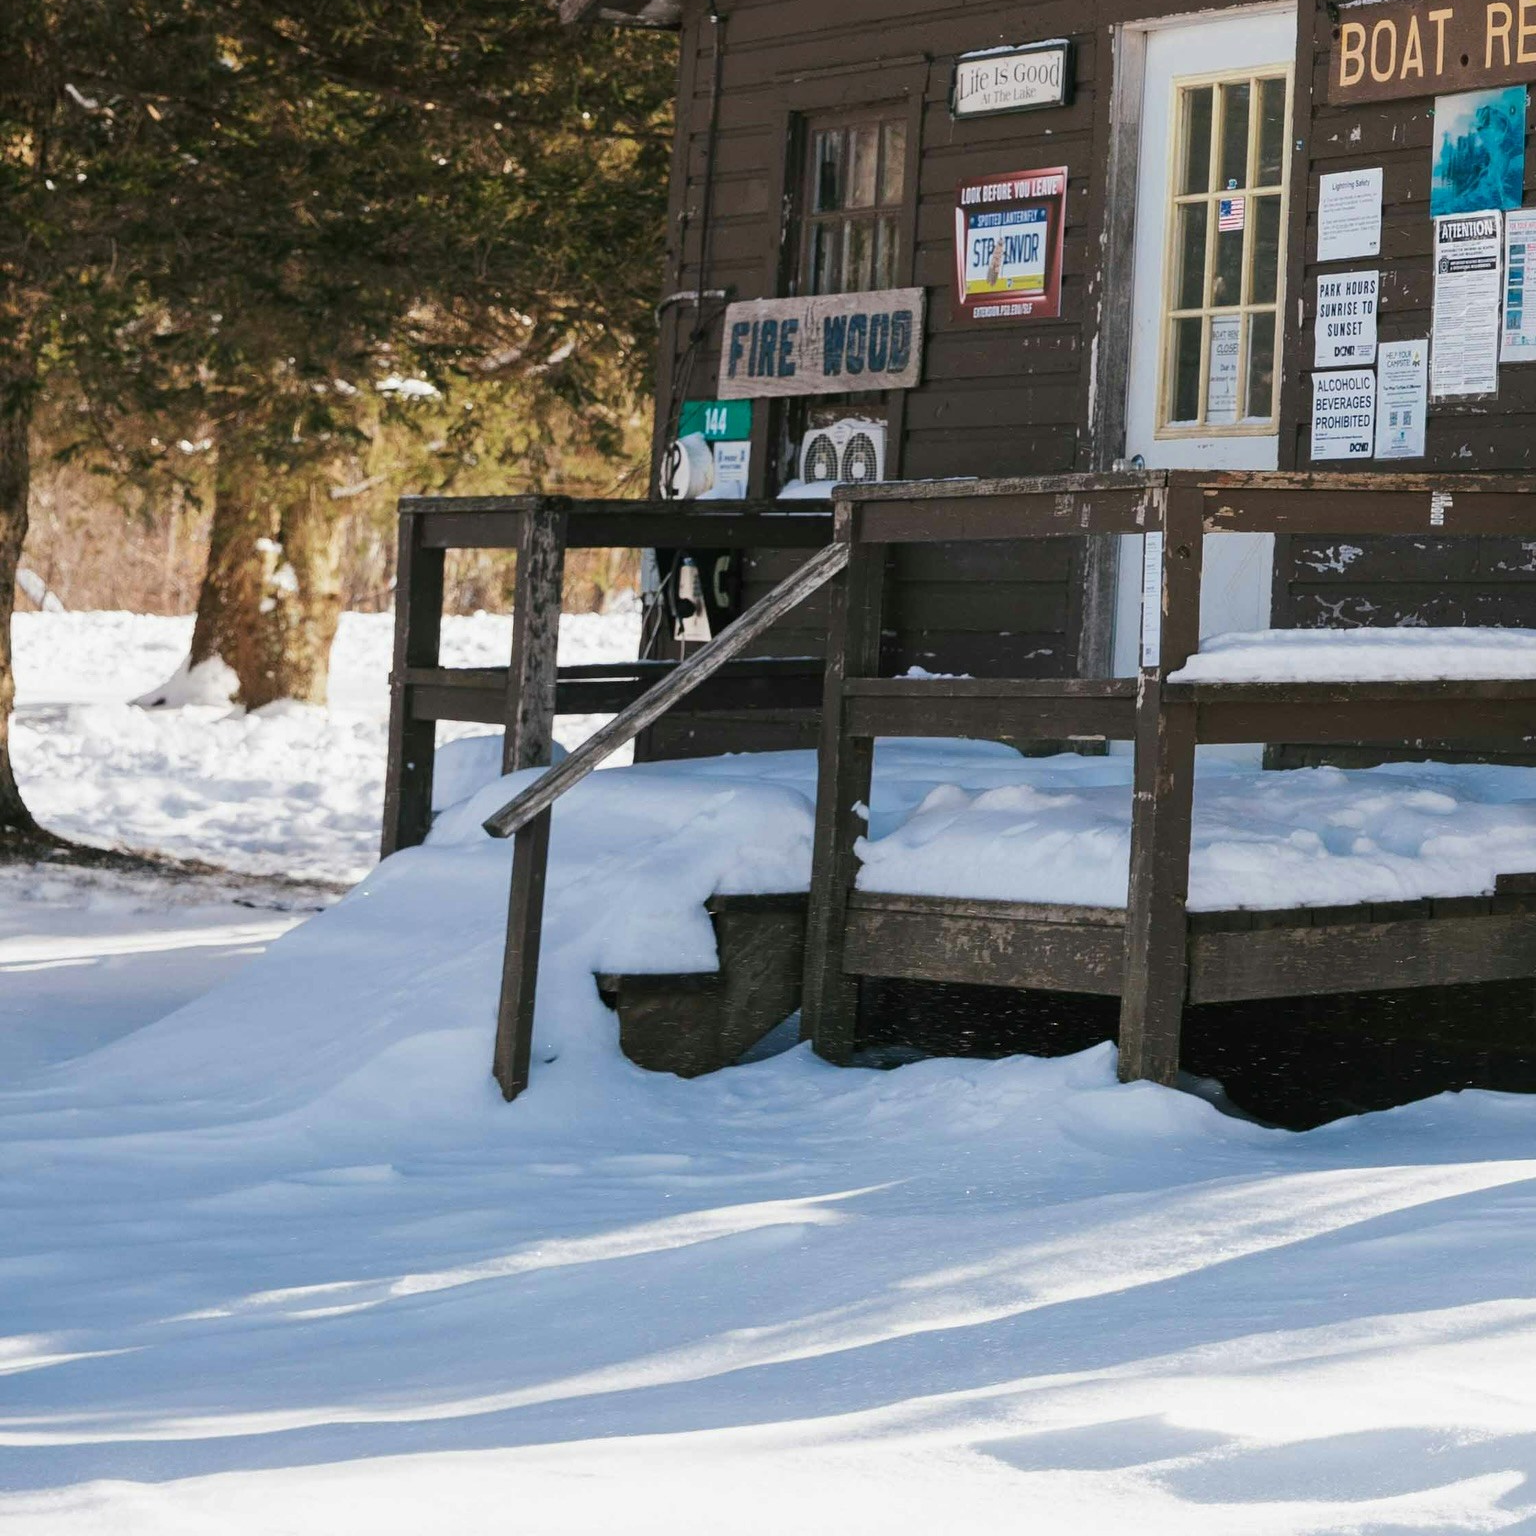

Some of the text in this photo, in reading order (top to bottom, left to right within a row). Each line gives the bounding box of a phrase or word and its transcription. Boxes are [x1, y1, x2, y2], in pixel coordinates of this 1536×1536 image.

[1339, 8, 1453, 86] BOAT
[960, 68, 989, 101] Life
[1013, 56, 1061, 88] Good
[1013, 85, 1037, 101] Lake
[961, 176, 1058, 205] LOOK BEFORE YOU LEAVE
[977, 209, 1038, 227] SPOTTED LANTERNFLY
[1441, 219, 1493, 240] ATTENTION
[973, 233, 1039, 268] STP INVDR
[1320, 280, 1376, 298] PARK HOURS
[1320, 300, 1373, 318] SUNRISE TO
[1327, 321, 1363, 337] SUNSET
[728, 310, 912, 379] FIRE WOOD
[1216, 343, 1238, 354] CLOSE
[1318, 377, 1370, 393] ALCOHOLIC
[1316, 395, 1372, 411] BEVERAGES
[705, 407, 727, 435] 144
[1316, 415, 1370, 430] PROHIBITED
